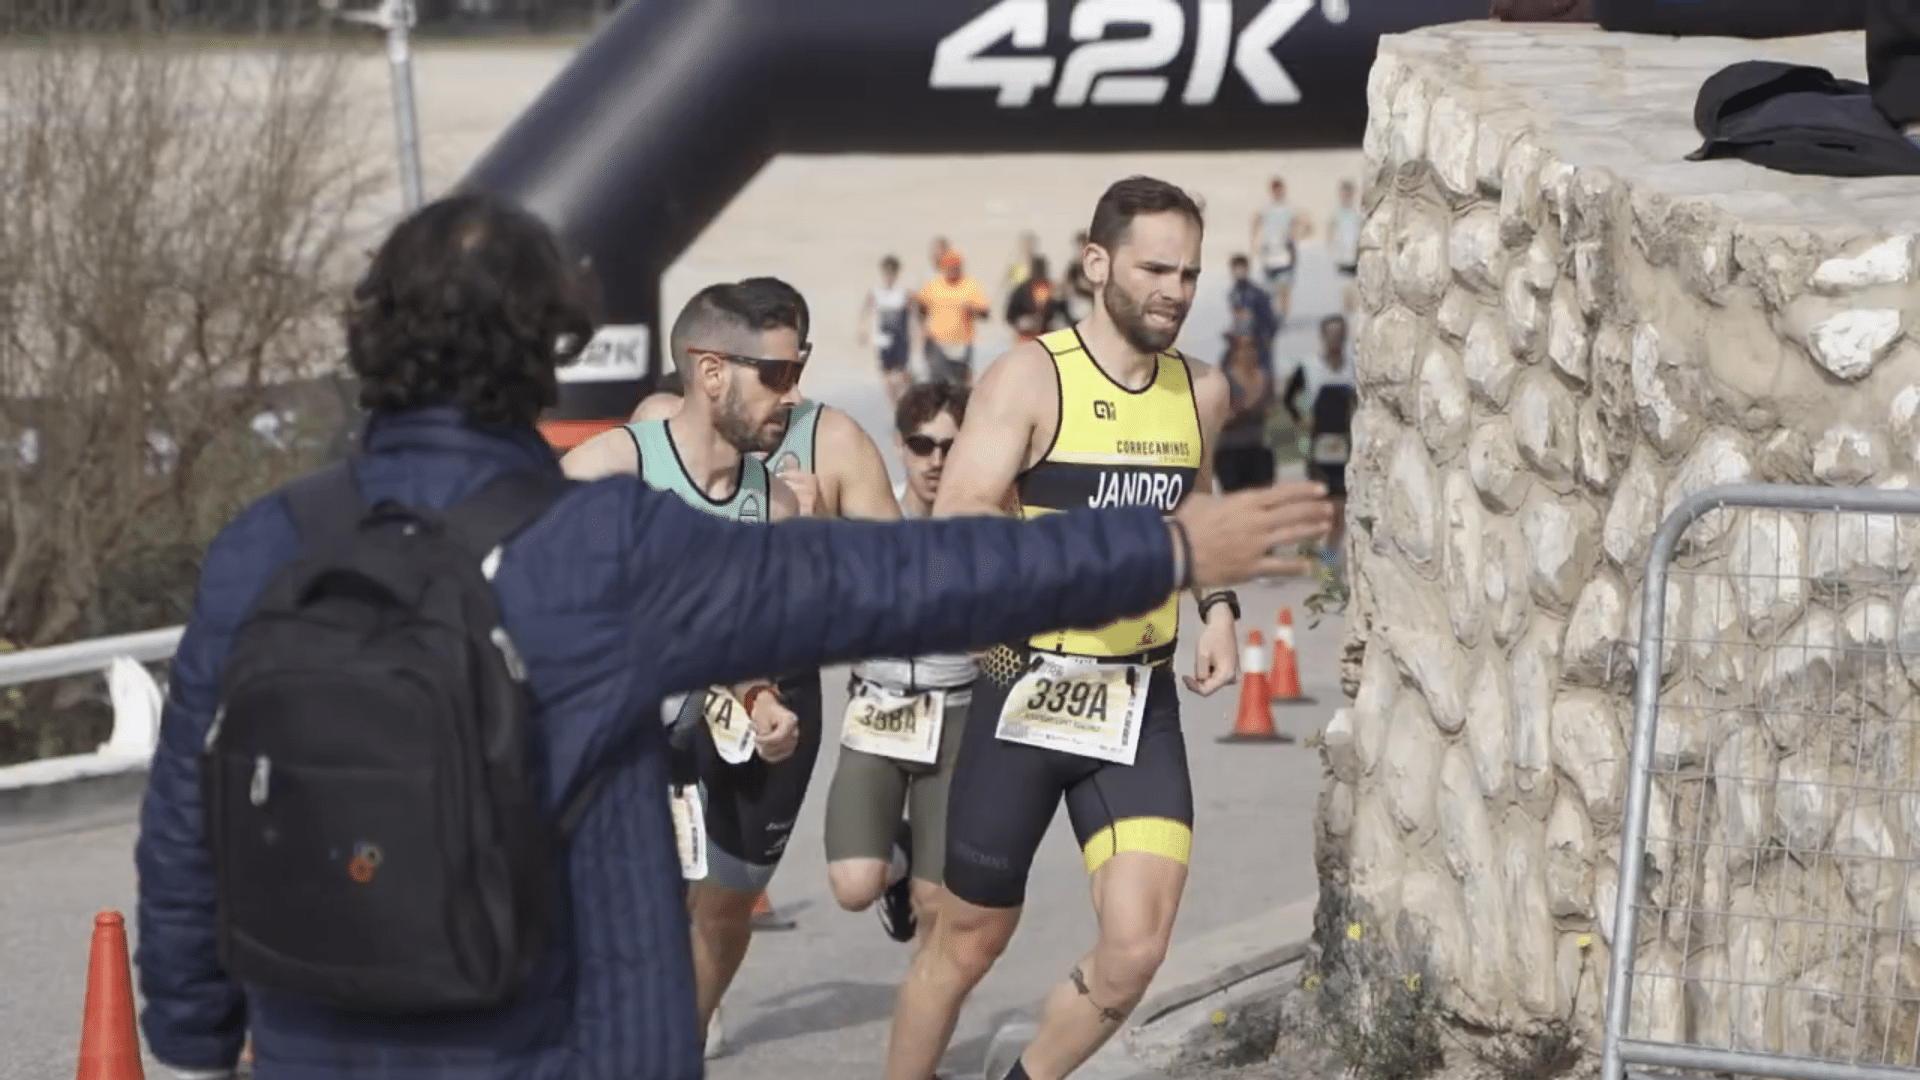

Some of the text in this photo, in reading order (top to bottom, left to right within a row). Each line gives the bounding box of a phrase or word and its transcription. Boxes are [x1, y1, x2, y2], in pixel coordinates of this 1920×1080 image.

[929, 0, 1301, 107] 42K
[1116, 440, 1189, 456] CORRECAMINOS
[1088, 471, 1183, 511] JANDRO
[1027, 678, 1108, 722] 339A
